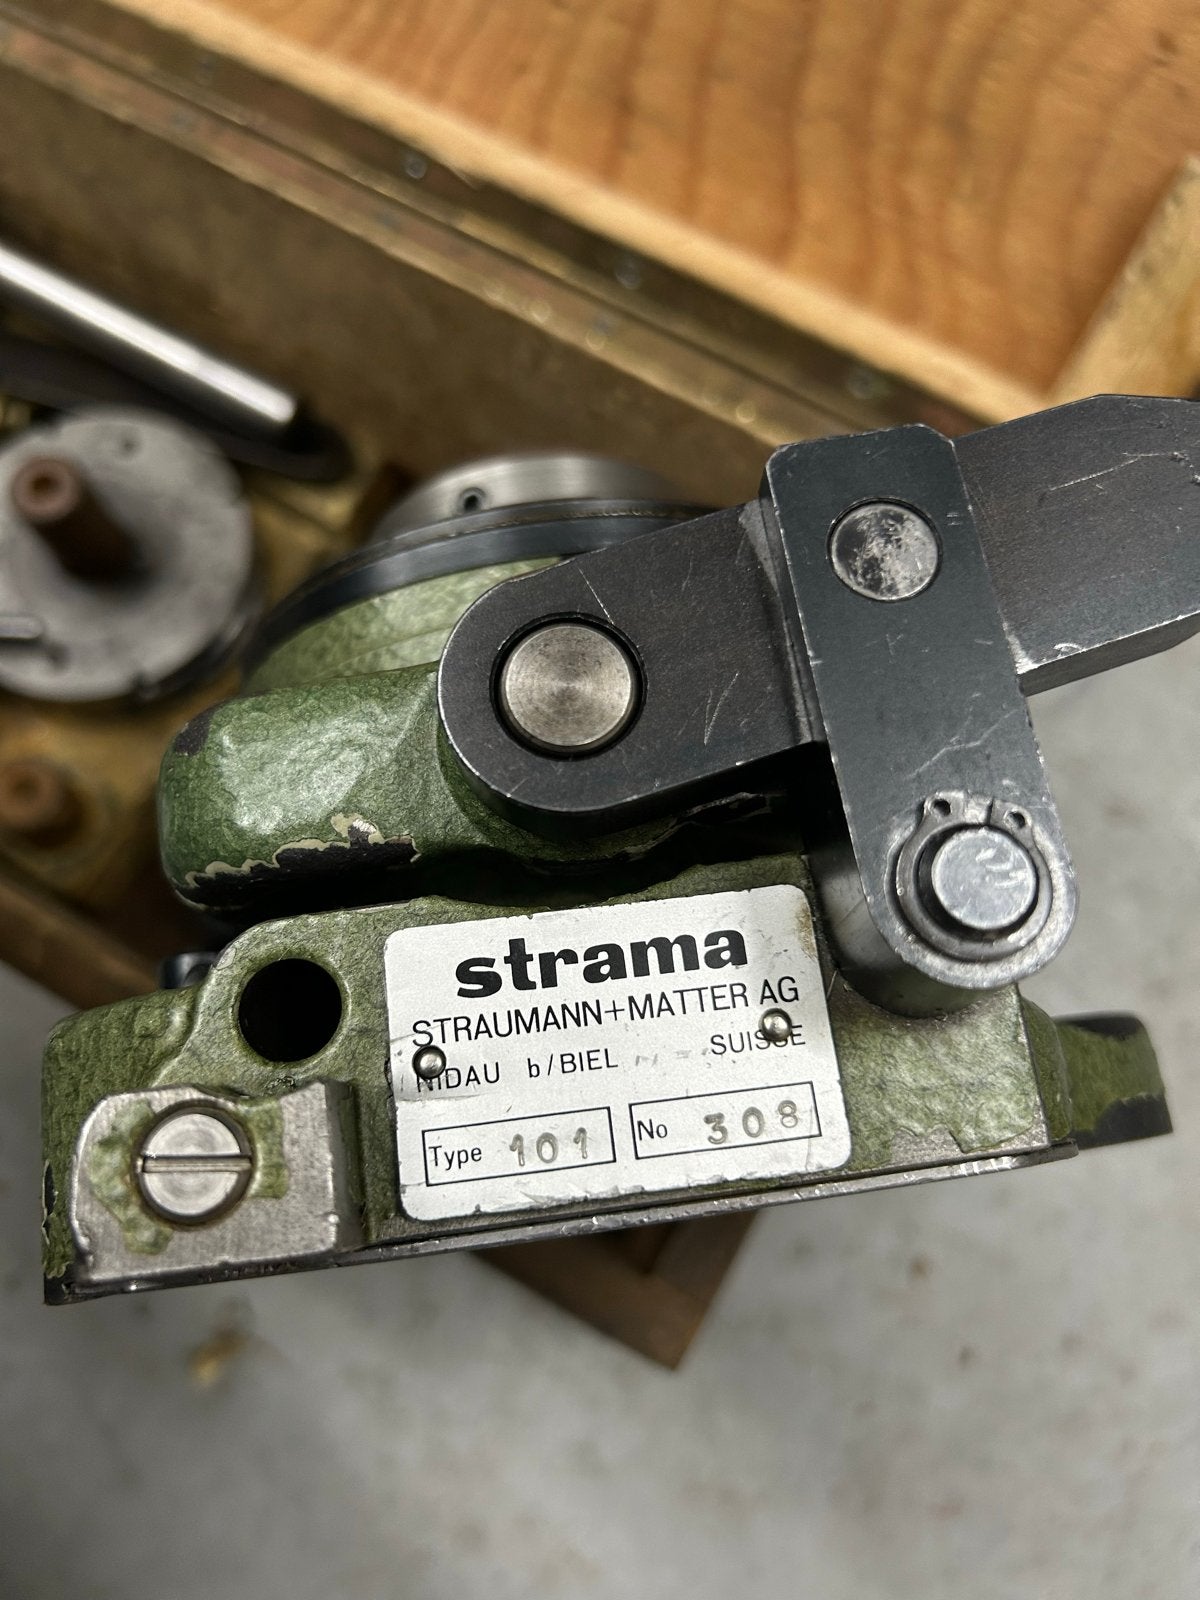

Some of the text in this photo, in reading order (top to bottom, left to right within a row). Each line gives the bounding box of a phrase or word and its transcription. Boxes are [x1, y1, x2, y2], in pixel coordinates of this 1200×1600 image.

[455, 929, 748, 998] strama
[412, 975, 800, 1047] STRAUMANN+MATTER AG
[428, 1127, 589, 1171] Type 101
[637, 1099, 799, 1145] No 308
